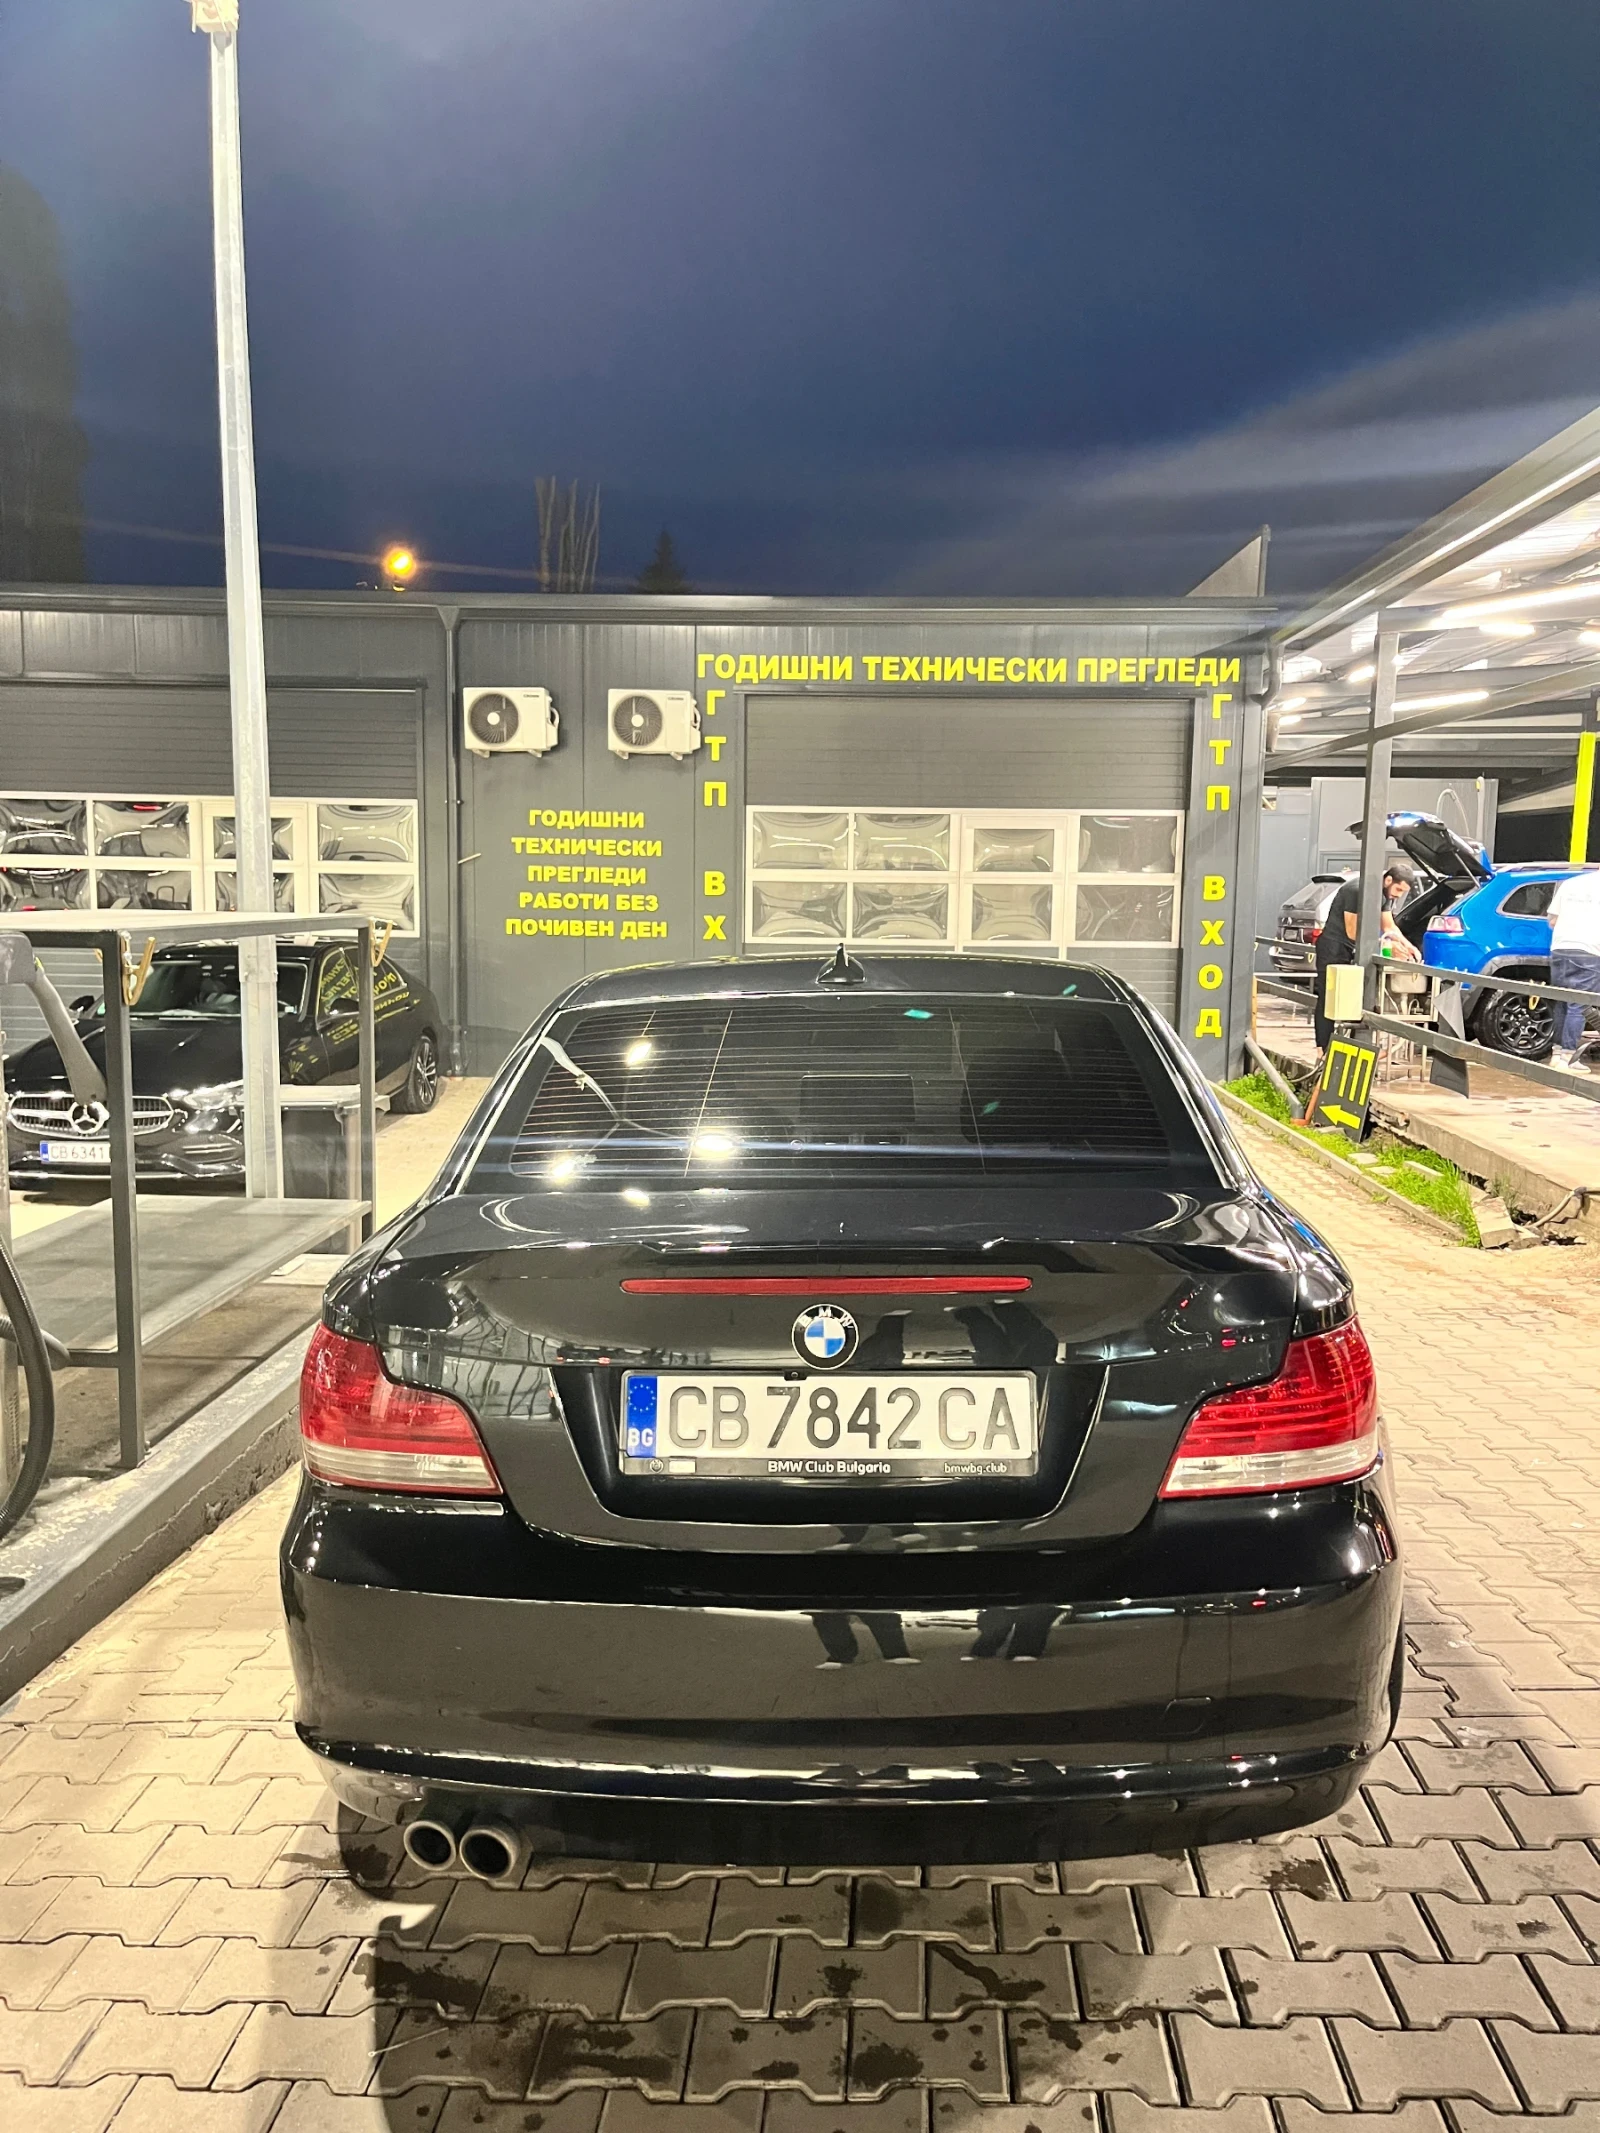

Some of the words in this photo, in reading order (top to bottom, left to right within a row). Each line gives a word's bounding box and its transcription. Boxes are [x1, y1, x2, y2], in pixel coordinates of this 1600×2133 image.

[697, 655, 853, 683] ГОДИШНИ
[862, 656, 1066, 683] ТЕХНИЧЕСКИ
[1078, 657, 1240, 686] ПРЕГЛЕДИ
[528, 810, 646, 829] ГОДИШНИ
[512, 838, 663, 858] ТЕХНИЧЕСКИ
[526, 865, 648, 887] ПРЕГЛЕДИ
[518, 892, 610, 911] РАБОТИ
[615, 895, 659, 913] БЕЗ
[504, 919, 616, 939] ПОЧИВЕН
[618, 921, 669, 941] ДЕН
[1194, 874, 1227, 1040] ВХОД
[1322, 1040, 1376, 1106] ГТП
[669, 1386, 749, 1449] CB
[767, 1386, 921, 1450] 7842
[939, 1387, 1020, 1450] CA
[627, 1428, 654, 1447] BG
[767, 1460, 802, 1473] BMW
[805, 1460, 835, 1473] Club
[837, 1460, 891, 1475] Bulgaria
[944, 1462, 1007, 1475] bmwbg.club
